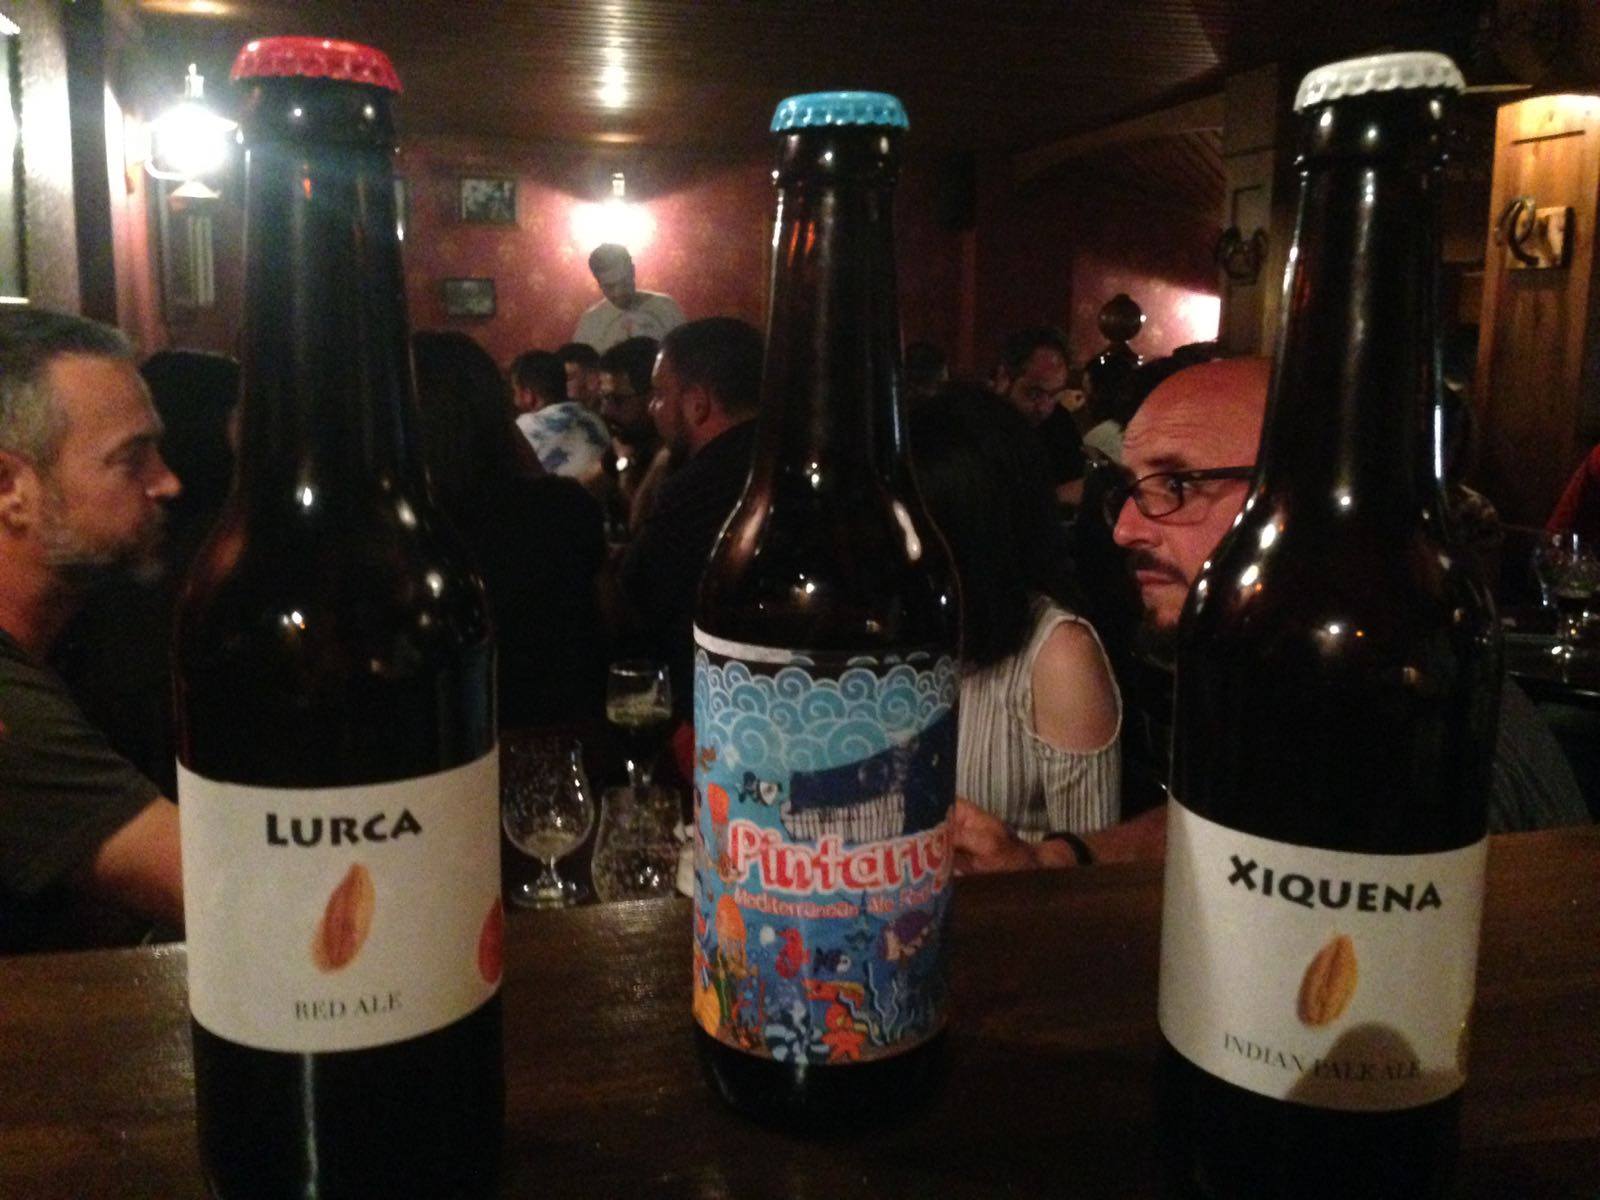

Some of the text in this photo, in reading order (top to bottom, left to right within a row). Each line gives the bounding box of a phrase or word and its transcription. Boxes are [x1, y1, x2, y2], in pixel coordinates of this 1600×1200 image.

[266, 808, 423, 848] LURCA
[1227, 854, 1443, 912] XIQUENA
[295, 993, 404, 1021] RED ALE
[1223, 1032, 1421, 1081] INDIAN PALE ALE
